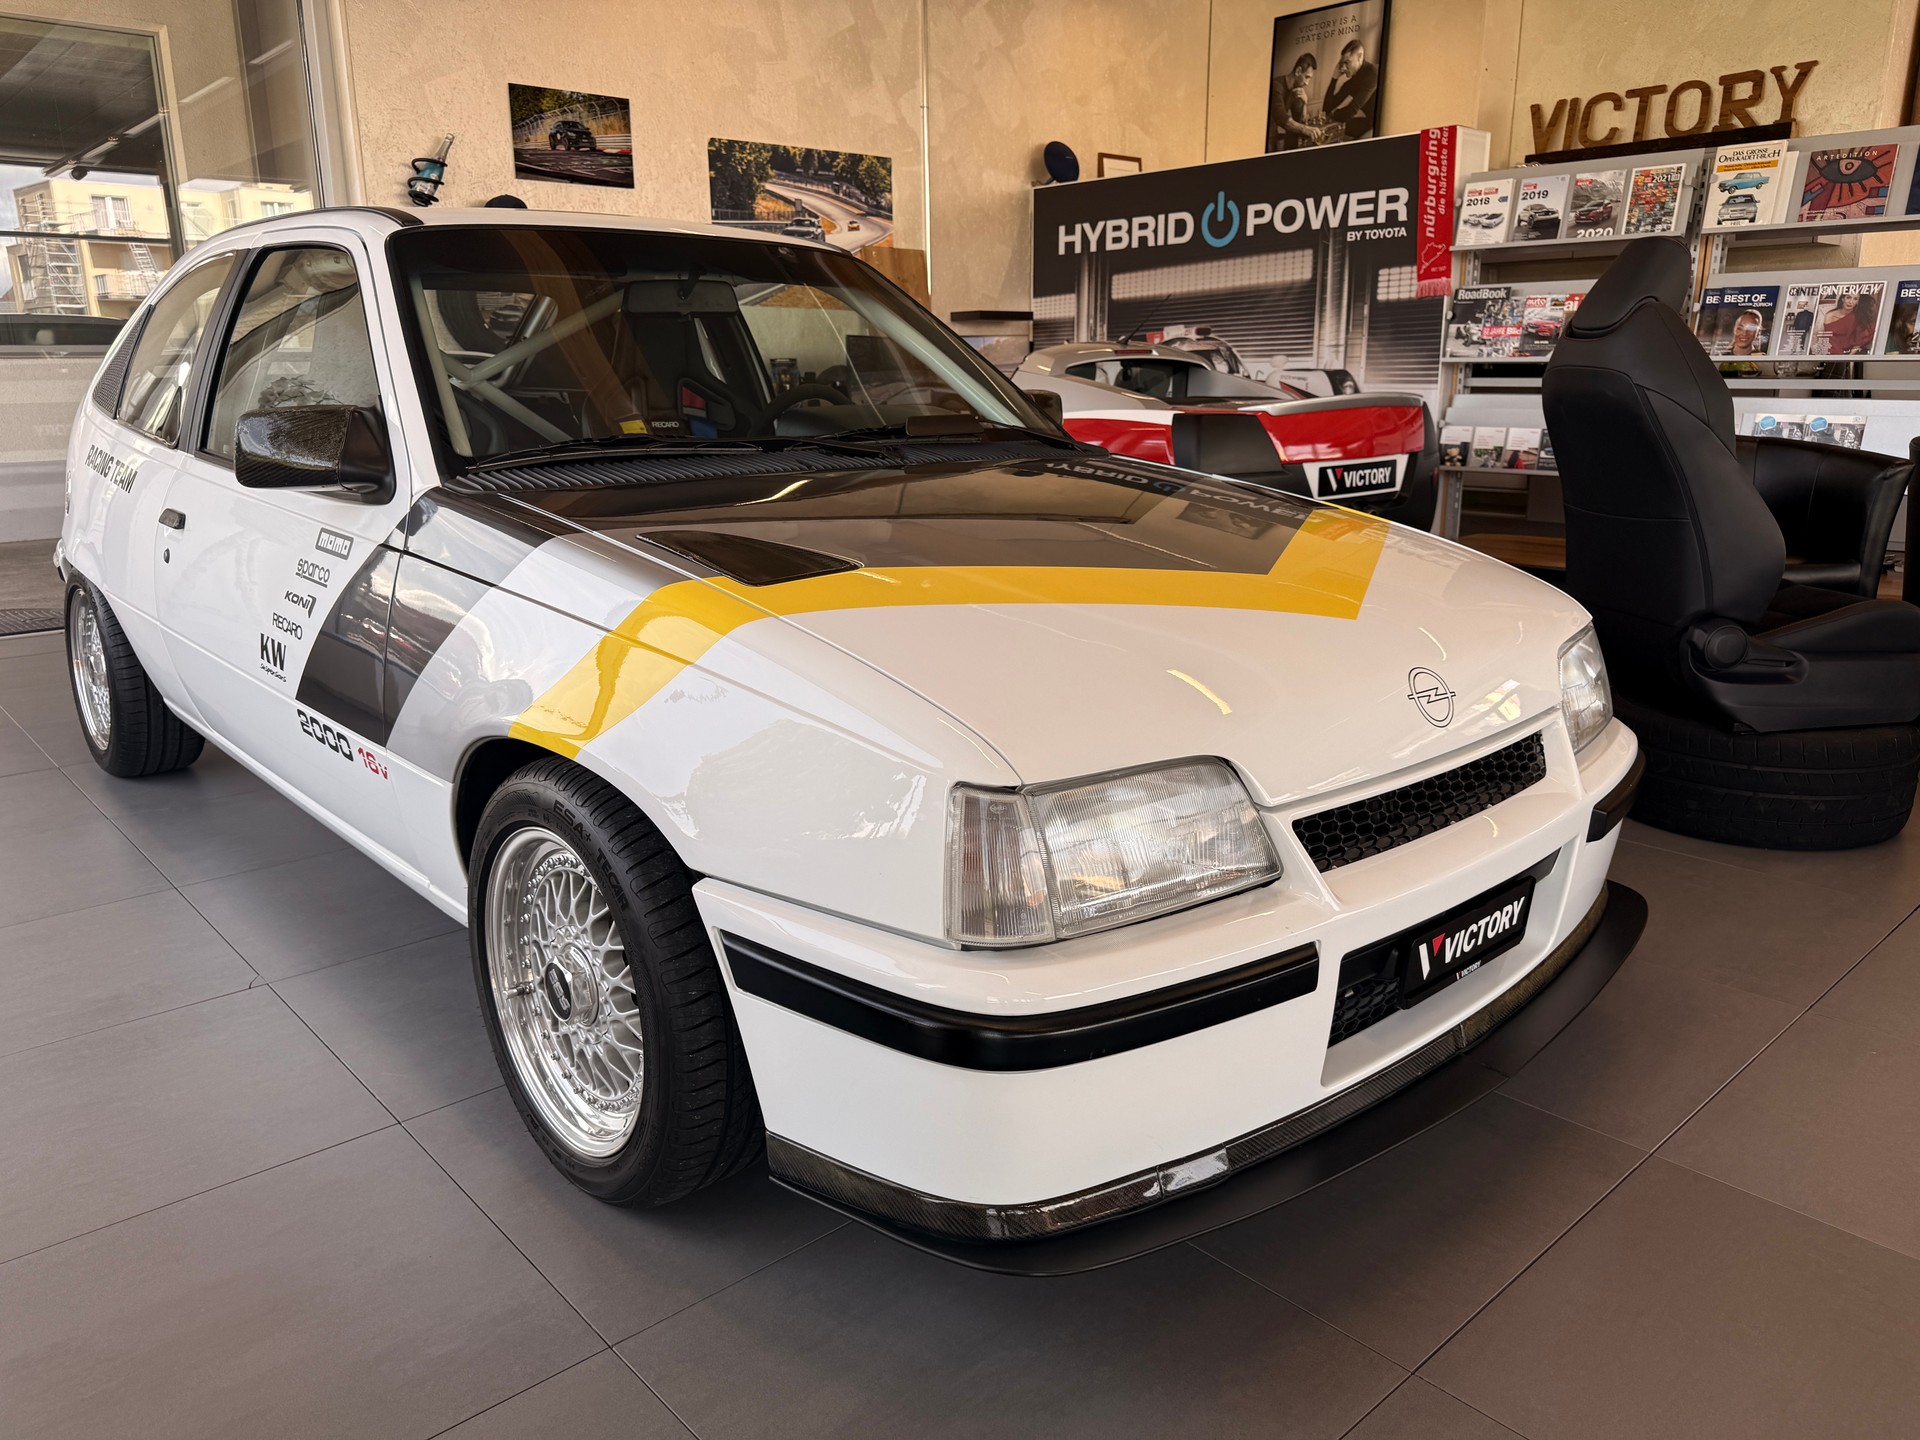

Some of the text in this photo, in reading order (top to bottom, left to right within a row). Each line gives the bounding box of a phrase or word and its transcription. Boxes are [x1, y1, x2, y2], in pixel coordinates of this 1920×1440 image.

[1295, 25, 1360, 45] STATE OF MIND
[1299, 19, 1338, 33] VICTORY
[1340, 17, 1348, 25] IS
[1530, 60, 1819, 154] VICTORY
[1816, 150, 1878, 161] ARTEDITION
[1439, 149, 1449, 195] härteste
[1653, 174, 1672, 183] 2021
[1424, 128, 1441, 238] nürburgring
[1466, 197, 1490, 207] 2018
[1521, 190, 1549, 201] 2019
[1438, 199, 1446, 214] die
[1058, 187, 1409, 255] HYBRID POWER
[1346, 227, 1407, 242] BY TOYOTA
[1576, 227, 1614, 239] 2020
[1457, 287, 1508, 300] RoadBook
[1526, 297, 1546, 305] auto
[1724, 293, 1767, 303] BEST OF
[85, 444, 138, 493] RACING TEAM
[1343, 466, 1391, 488] VICTORY
[297, 558, 330, 583] sparco
[284, 590, 311, 611] KONI
[272, 612, 303, 640] RECARO
[260, 632, 286, 671] KW
[297, 708, 354, 762] 2000
[1445, 896, 1525, 964] VICTORY
[1461, 959, 1481, 977] VICTORY
